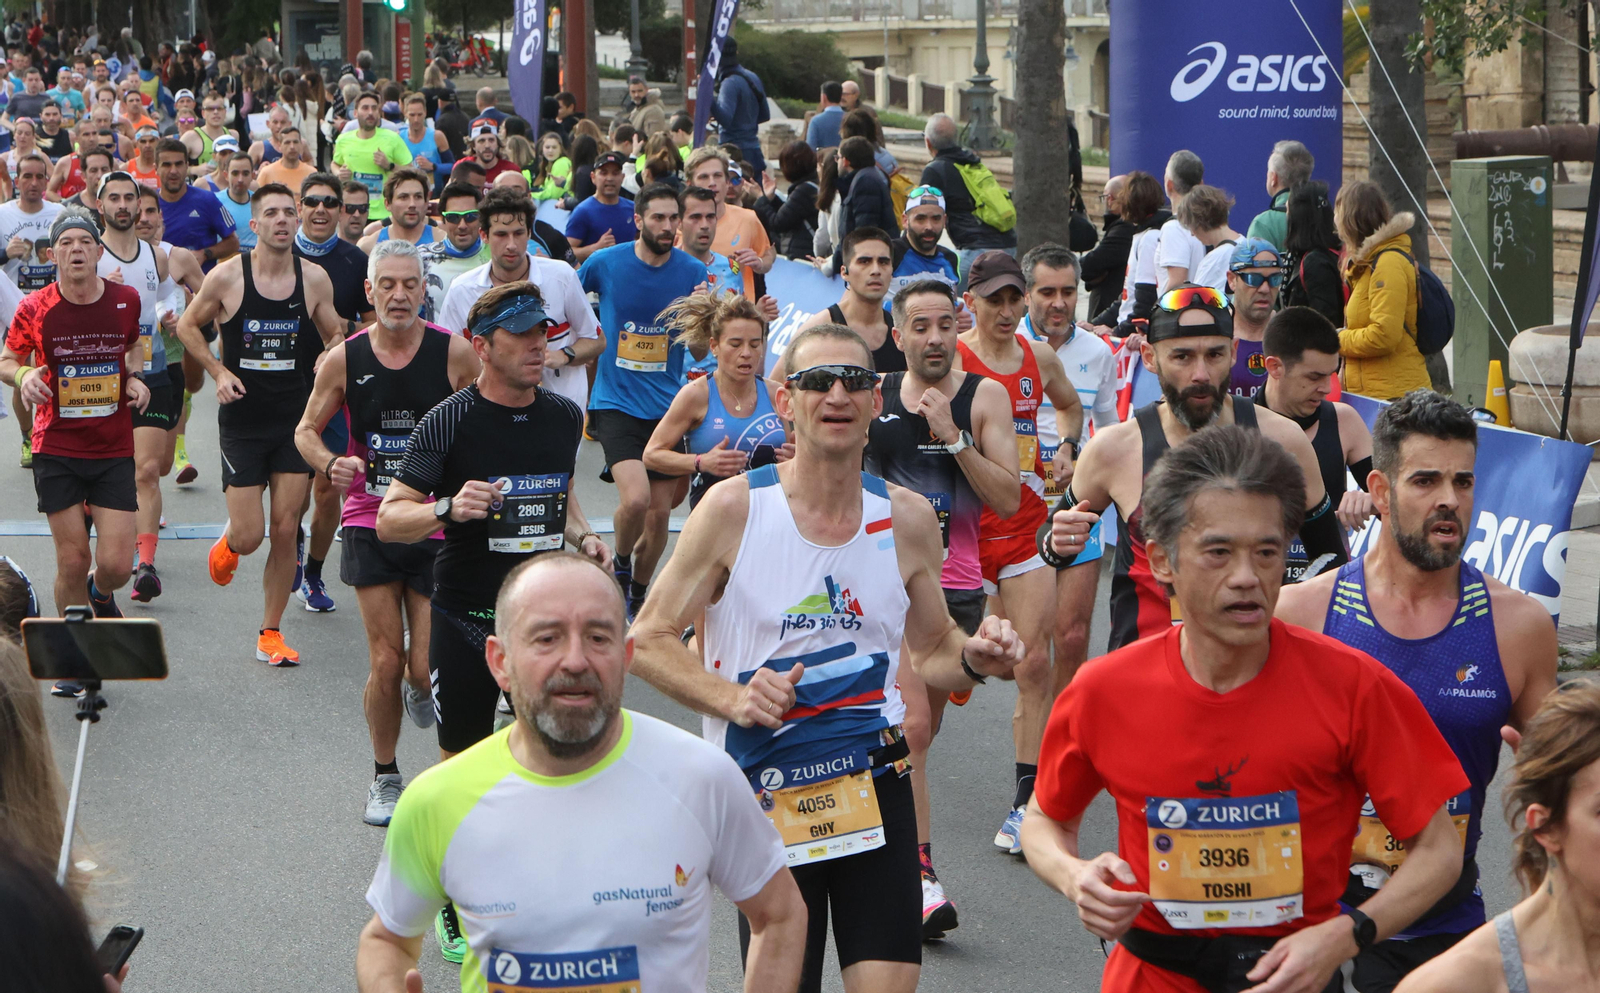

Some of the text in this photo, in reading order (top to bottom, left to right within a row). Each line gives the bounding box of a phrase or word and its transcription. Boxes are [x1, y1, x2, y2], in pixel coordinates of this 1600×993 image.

[1218, 106, 1337, 120] sound mind, sound body
[262, 339, 281, 347] 2160
[636, 341, 654, 350] 4373
[80, 364, 114, 375] ZURICH
[80, 383, 102, 393] 6019
[67, 396, 115, 406] JOSE MANUEL
[1013, 422, 1033, 432] RICH
[384, 440, 407, 448] ZUR
[384, 460, 404, 470] 335
[517, 478, 561, 490] ZURICH
[517, 504, 545, 517] 2809
[517, 524, 546, 535] JESUS
[791, 755, 855, 781] ZURICH
[797, 793, 836, 815] 4055
[1197, 802, 1281, 823] ZURICH
[810, 821, 835, 838] GUY
[1199, 847, 1250, 868] 3936
[593, 884, 672, 905] gasNatural
[1202, 882, 1252, 898] TOSHI
[529, 956, 619, 981] ZURICH
